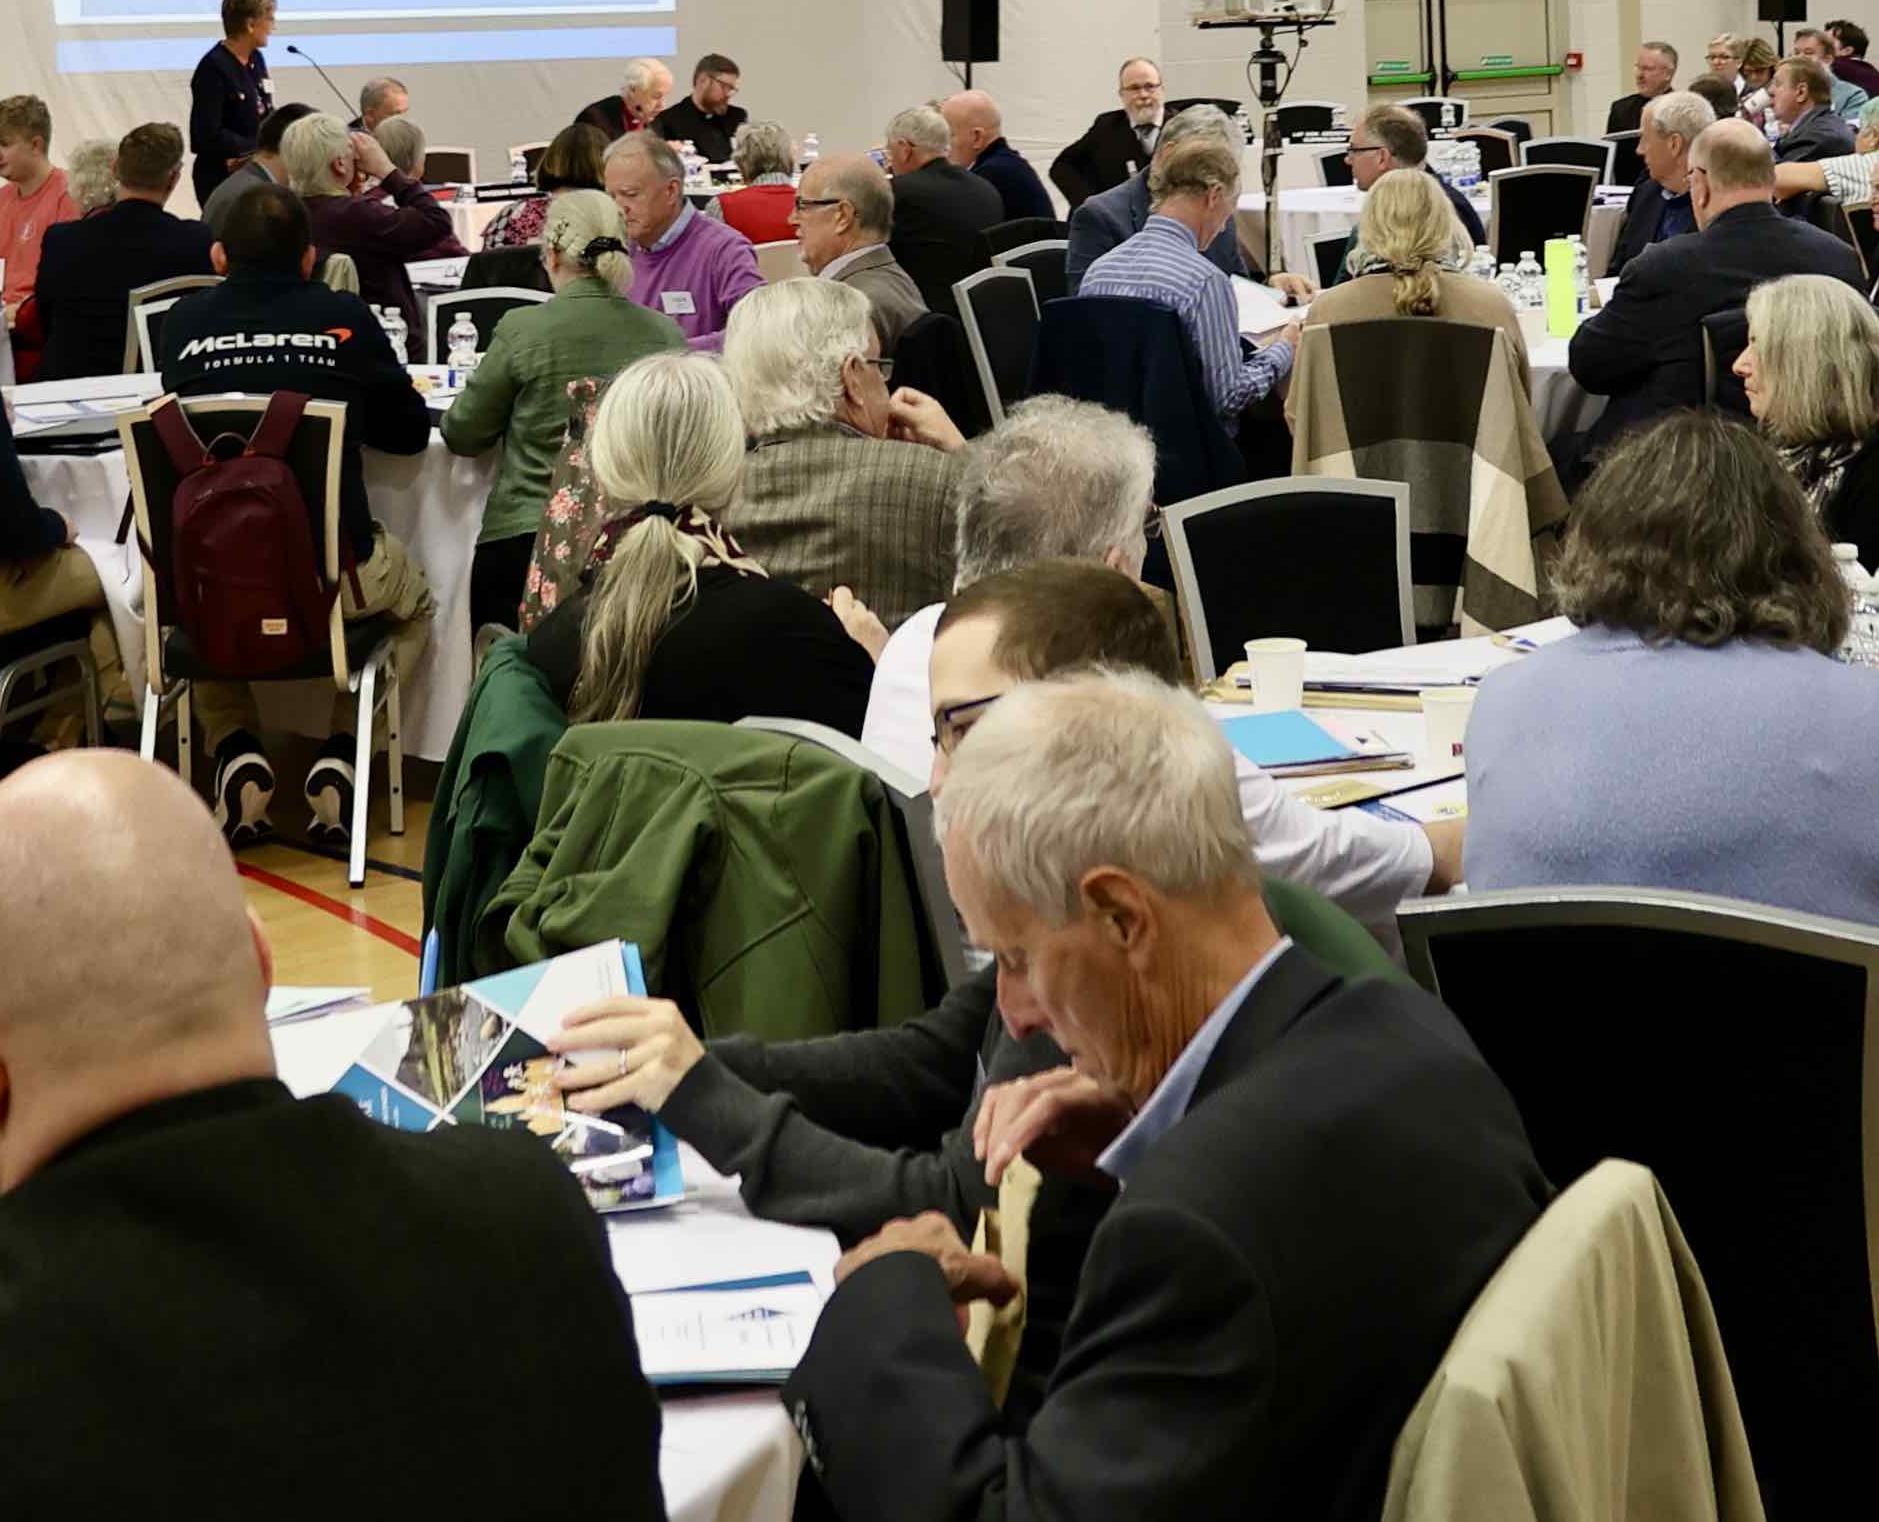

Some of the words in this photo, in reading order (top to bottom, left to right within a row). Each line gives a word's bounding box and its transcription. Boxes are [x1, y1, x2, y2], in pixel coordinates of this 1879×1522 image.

[177, 332, 337, 361] McLaren
[204, 354, 275, 370] FORMULA
[284, 354, 291, 364] 1
[299, 354, 336, 367] TEAM
